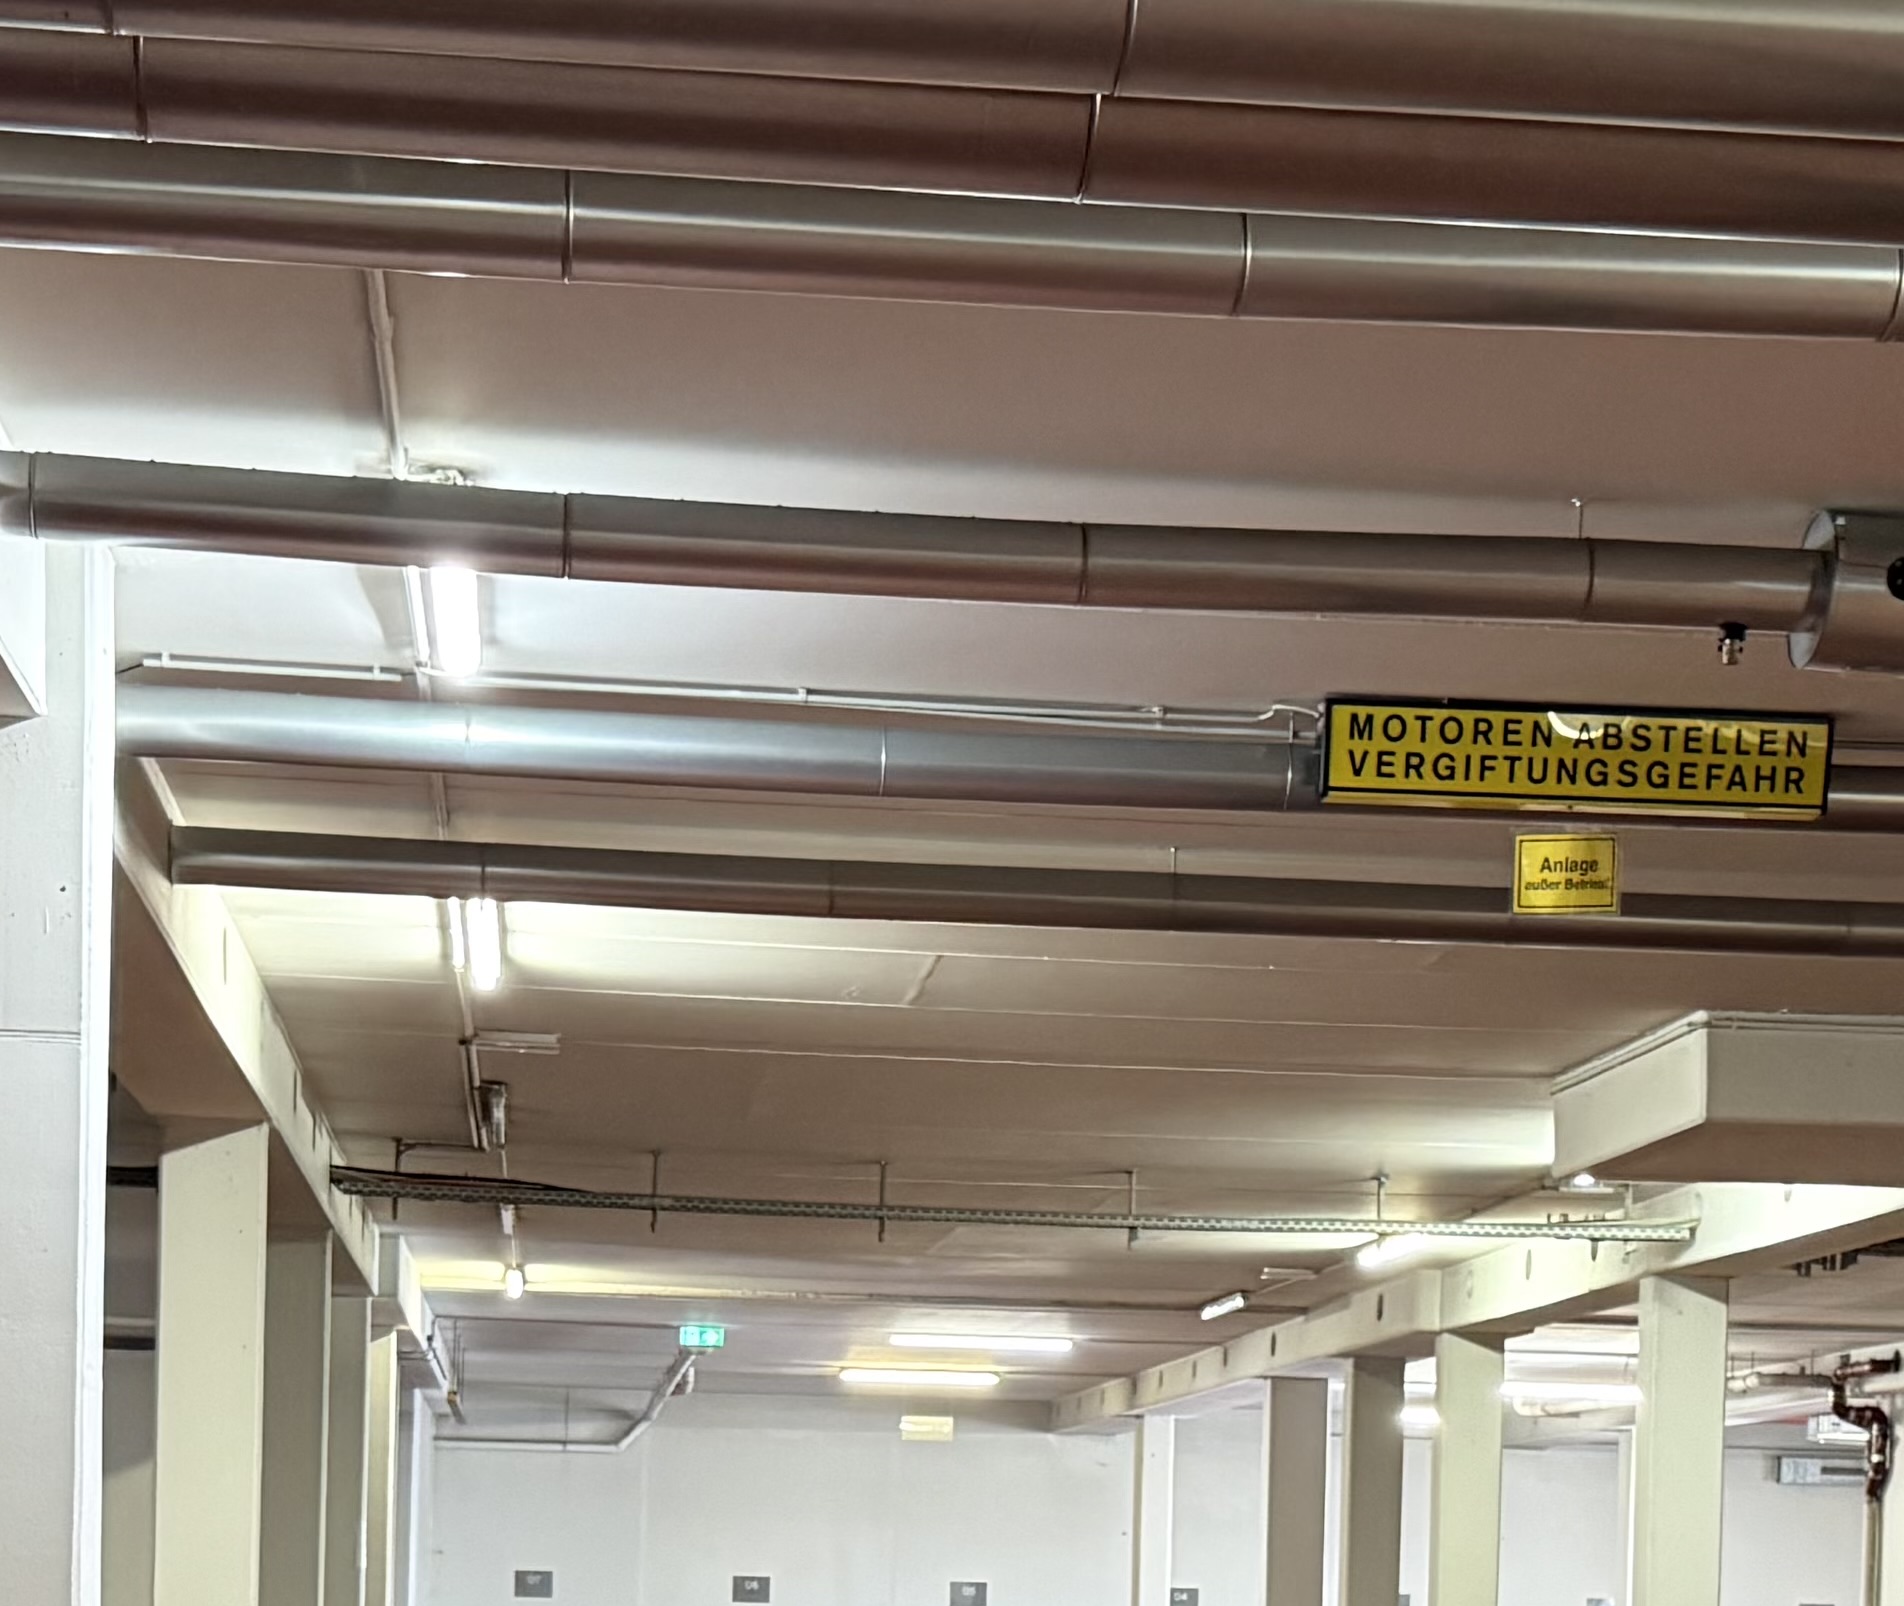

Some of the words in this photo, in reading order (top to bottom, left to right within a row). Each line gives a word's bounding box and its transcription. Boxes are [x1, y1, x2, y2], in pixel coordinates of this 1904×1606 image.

[1349, 712, 1552, 748] MOTOREN
[1573, 721, 1808, 759] ABSTELLEN
[1348, 749, 1805, 794] VERGIFTUNGSGEFAHR
[1540, 857, 1599, 876] Anlage
[1525, 879, 1561, 890] außer
